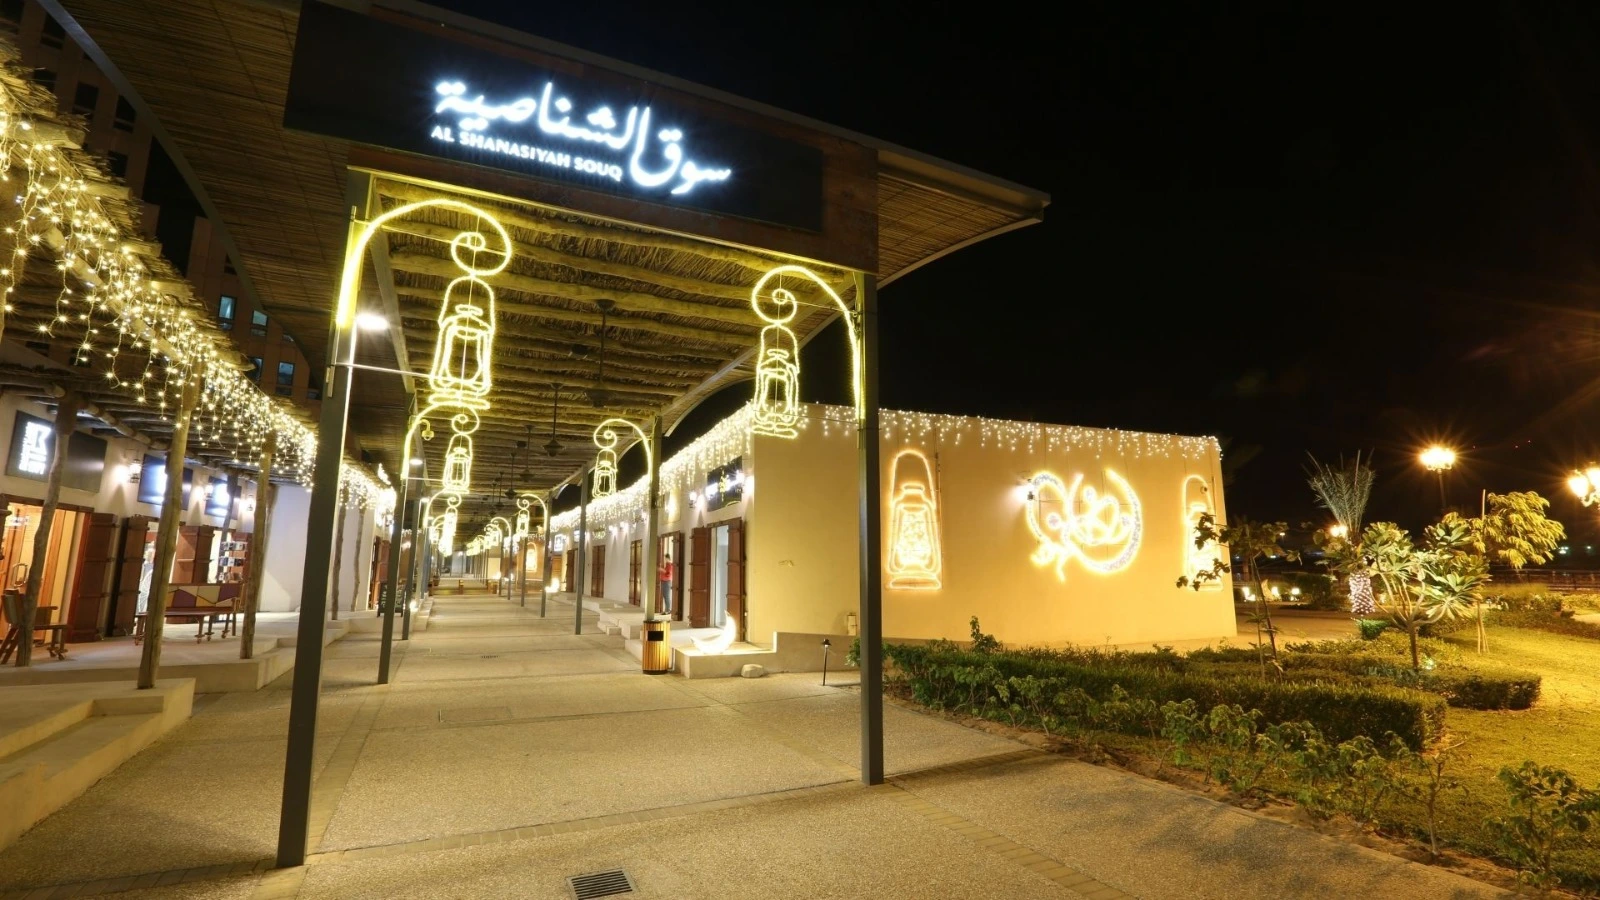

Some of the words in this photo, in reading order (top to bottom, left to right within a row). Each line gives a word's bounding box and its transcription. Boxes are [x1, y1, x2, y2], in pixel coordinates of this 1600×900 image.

[435, 81, 651, 149] الشناصية
[430, 125, 455, 143] AL
[459, 130, 571, 168] SHANASIYAH
[574, 156, 623, 182] SOUQ
[630, 115, 732, 196] سوق
